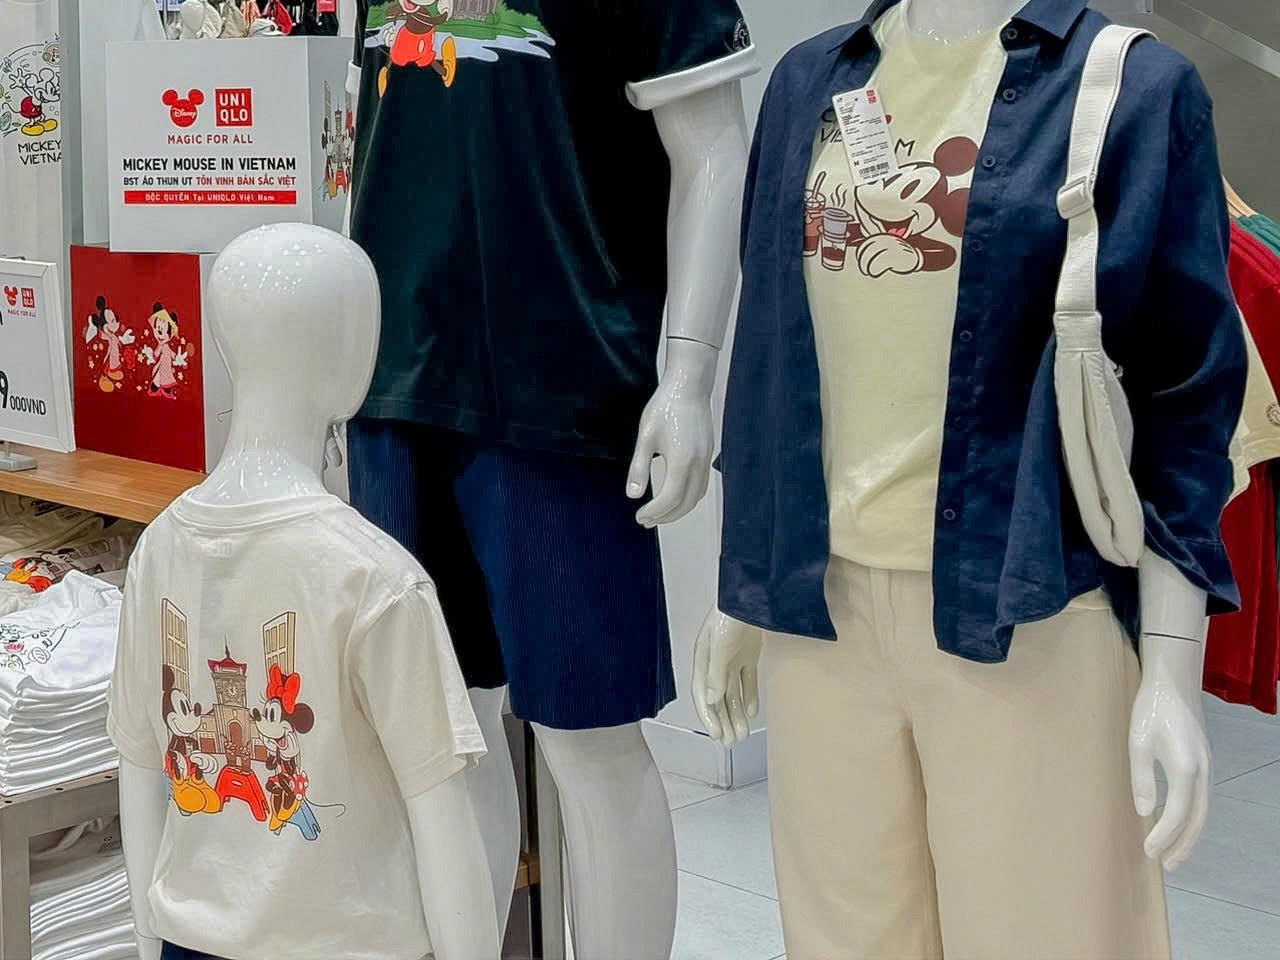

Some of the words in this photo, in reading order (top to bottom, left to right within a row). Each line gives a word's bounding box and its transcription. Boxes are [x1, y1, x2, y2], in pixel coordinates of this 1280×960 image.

[220, 92, 246, 107] UNI
[220, 108, 248, 124] QLO
[18, 138, 61, 153] MICKEY
[168, 134, 202, 145] MAGIC
[207, 134, 228, 145] FOR
[233, 134, 254, 144] ALL
[123, 157, 169, 171] MICKEY
[173, 157, 216, 171] MOUSE
[221, 157, 234, 171] IN
[238, 157, 296, 171] VIETNAM
[157, 176, 178, 186] THUN
[182, 176, 193, 186] UT
[215, 176, 234, 186] VINH
[207, 193, 236, 202] UNIQLO
